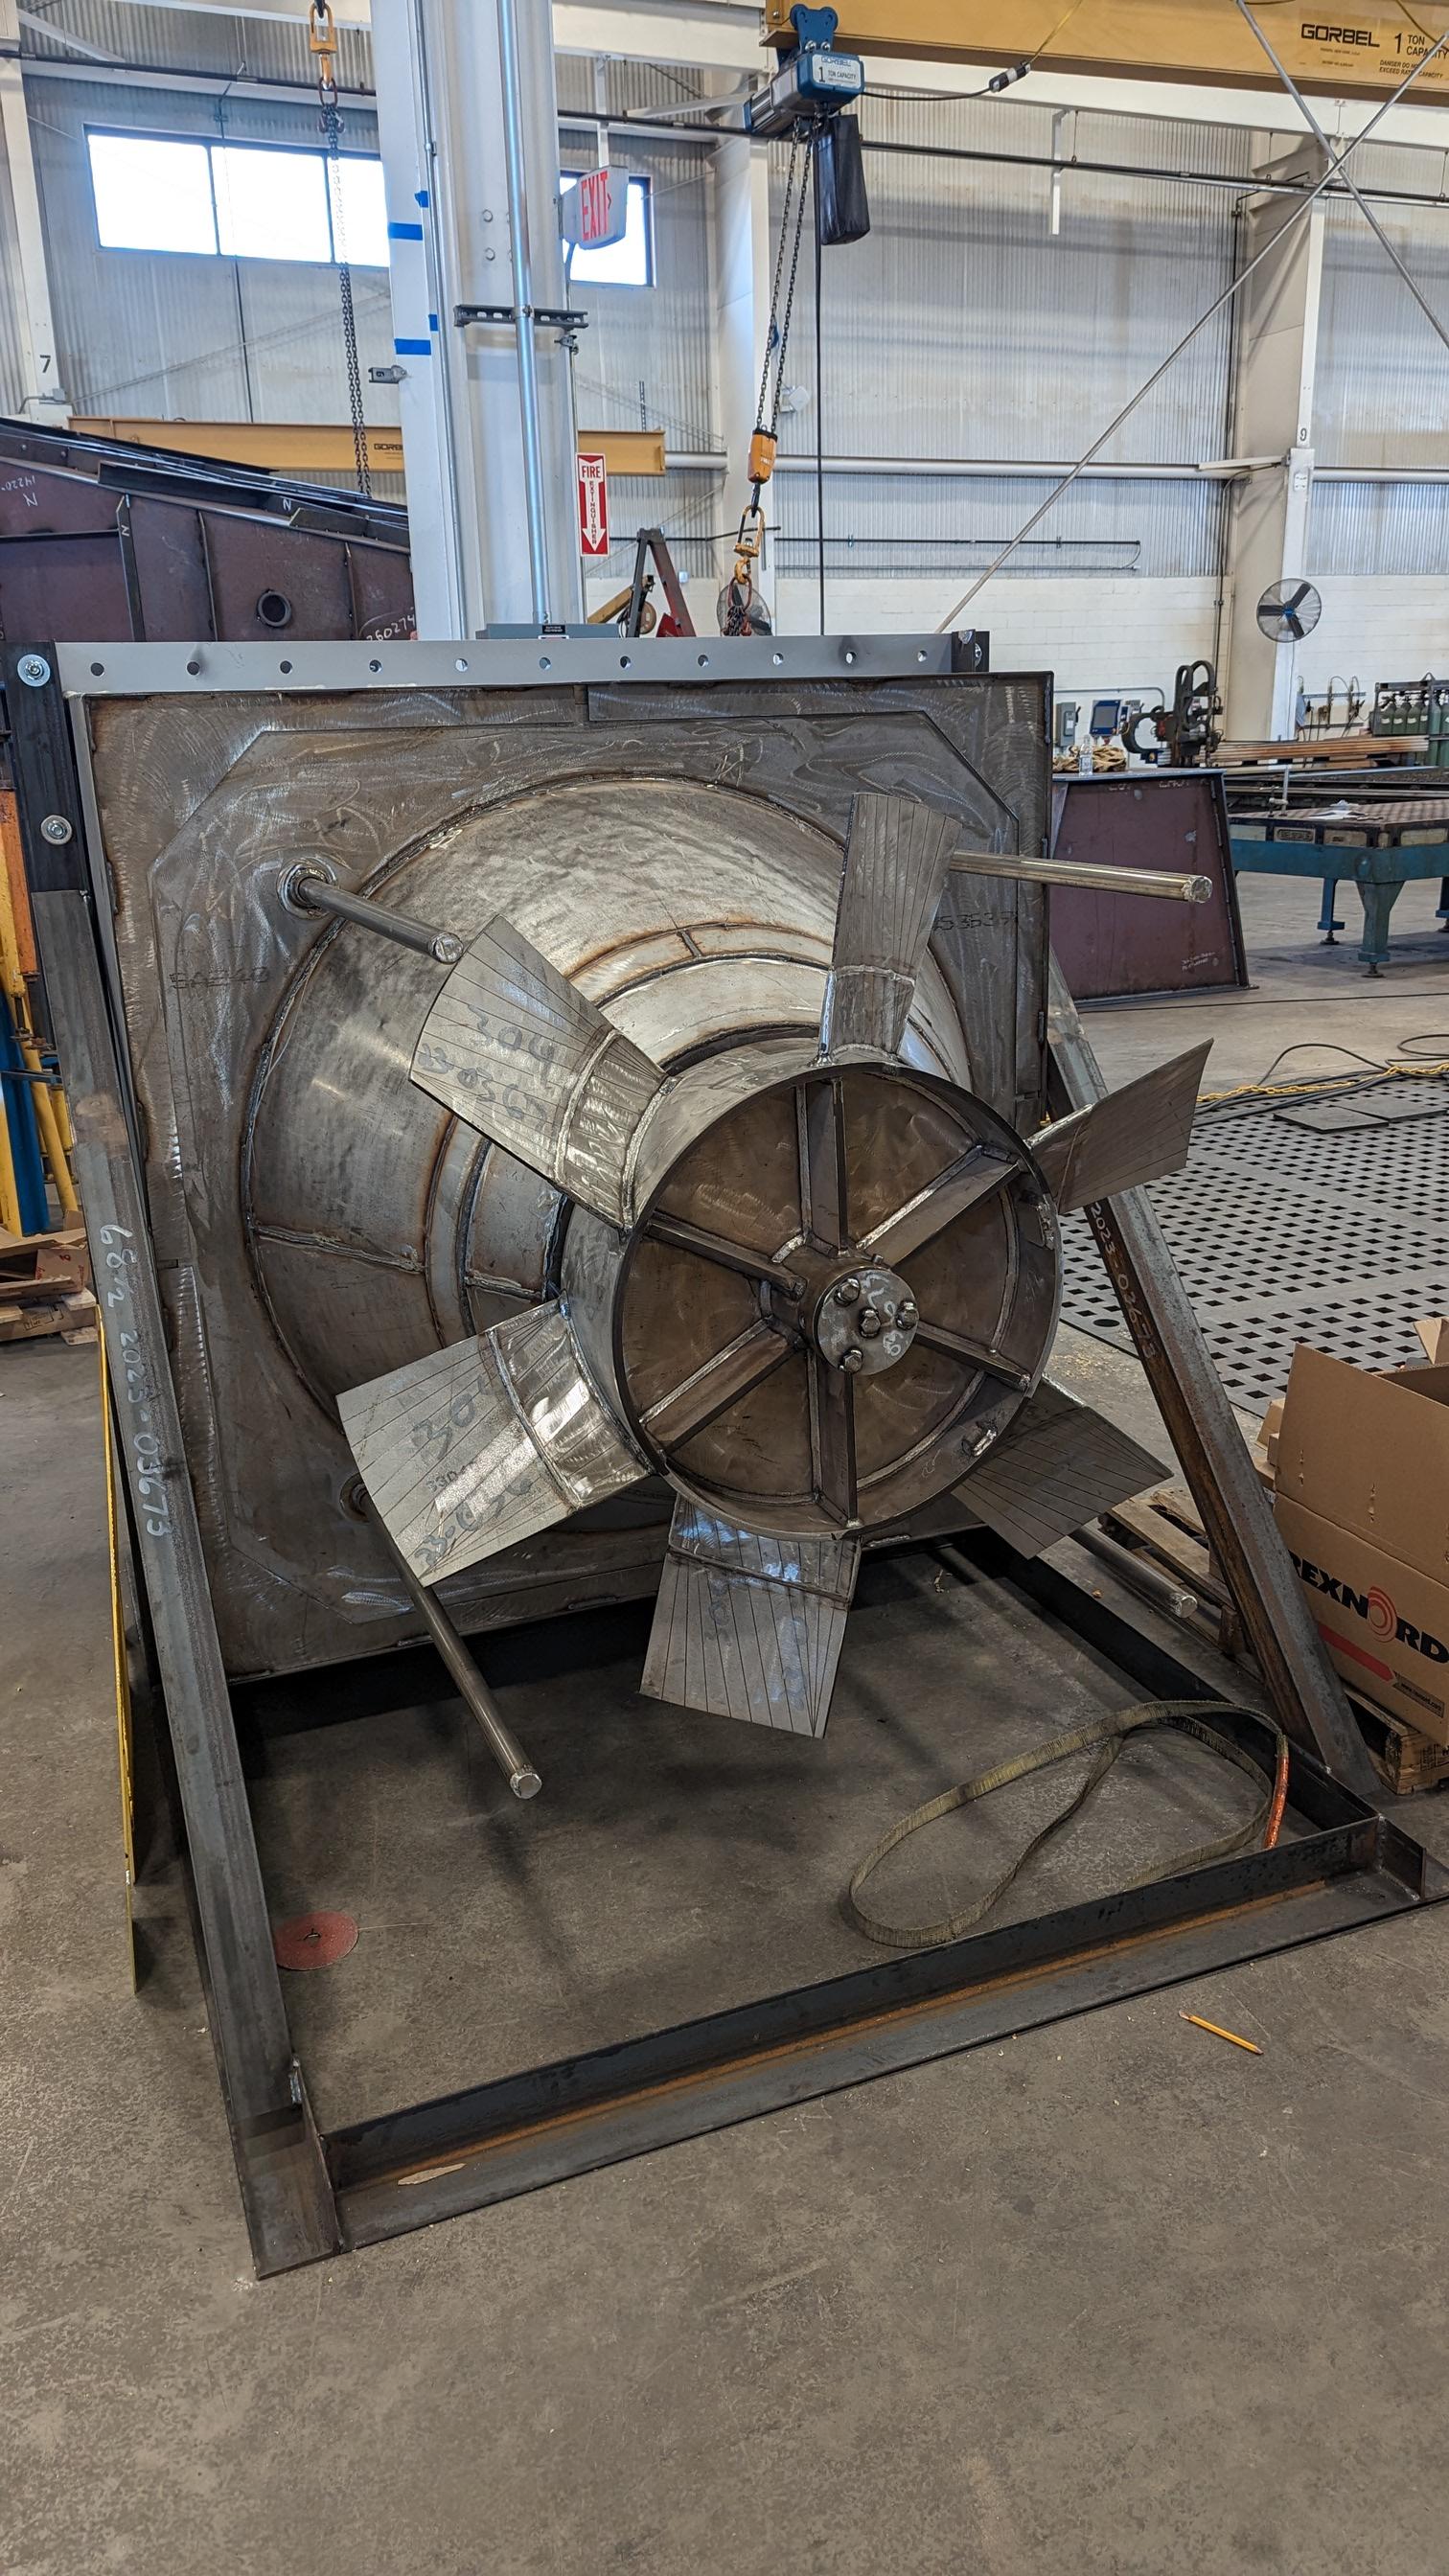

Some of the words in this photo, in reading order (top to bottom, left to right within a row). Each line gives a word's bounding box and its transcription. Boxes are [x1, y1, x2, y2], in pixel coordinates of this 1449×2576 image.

[1301, 23, 1380, 48] GORBEL
[1394, 33, 1402, 55] 1
[1408, 34, 1425, 45] TON
[818, 66, 825, 83] 1
[581, 171, 609, 242] EXIT
[39, 355, 51, 373] 7
[1300, 427, 1307, 442] 9
[582, 466, 601, 478] FIRE
